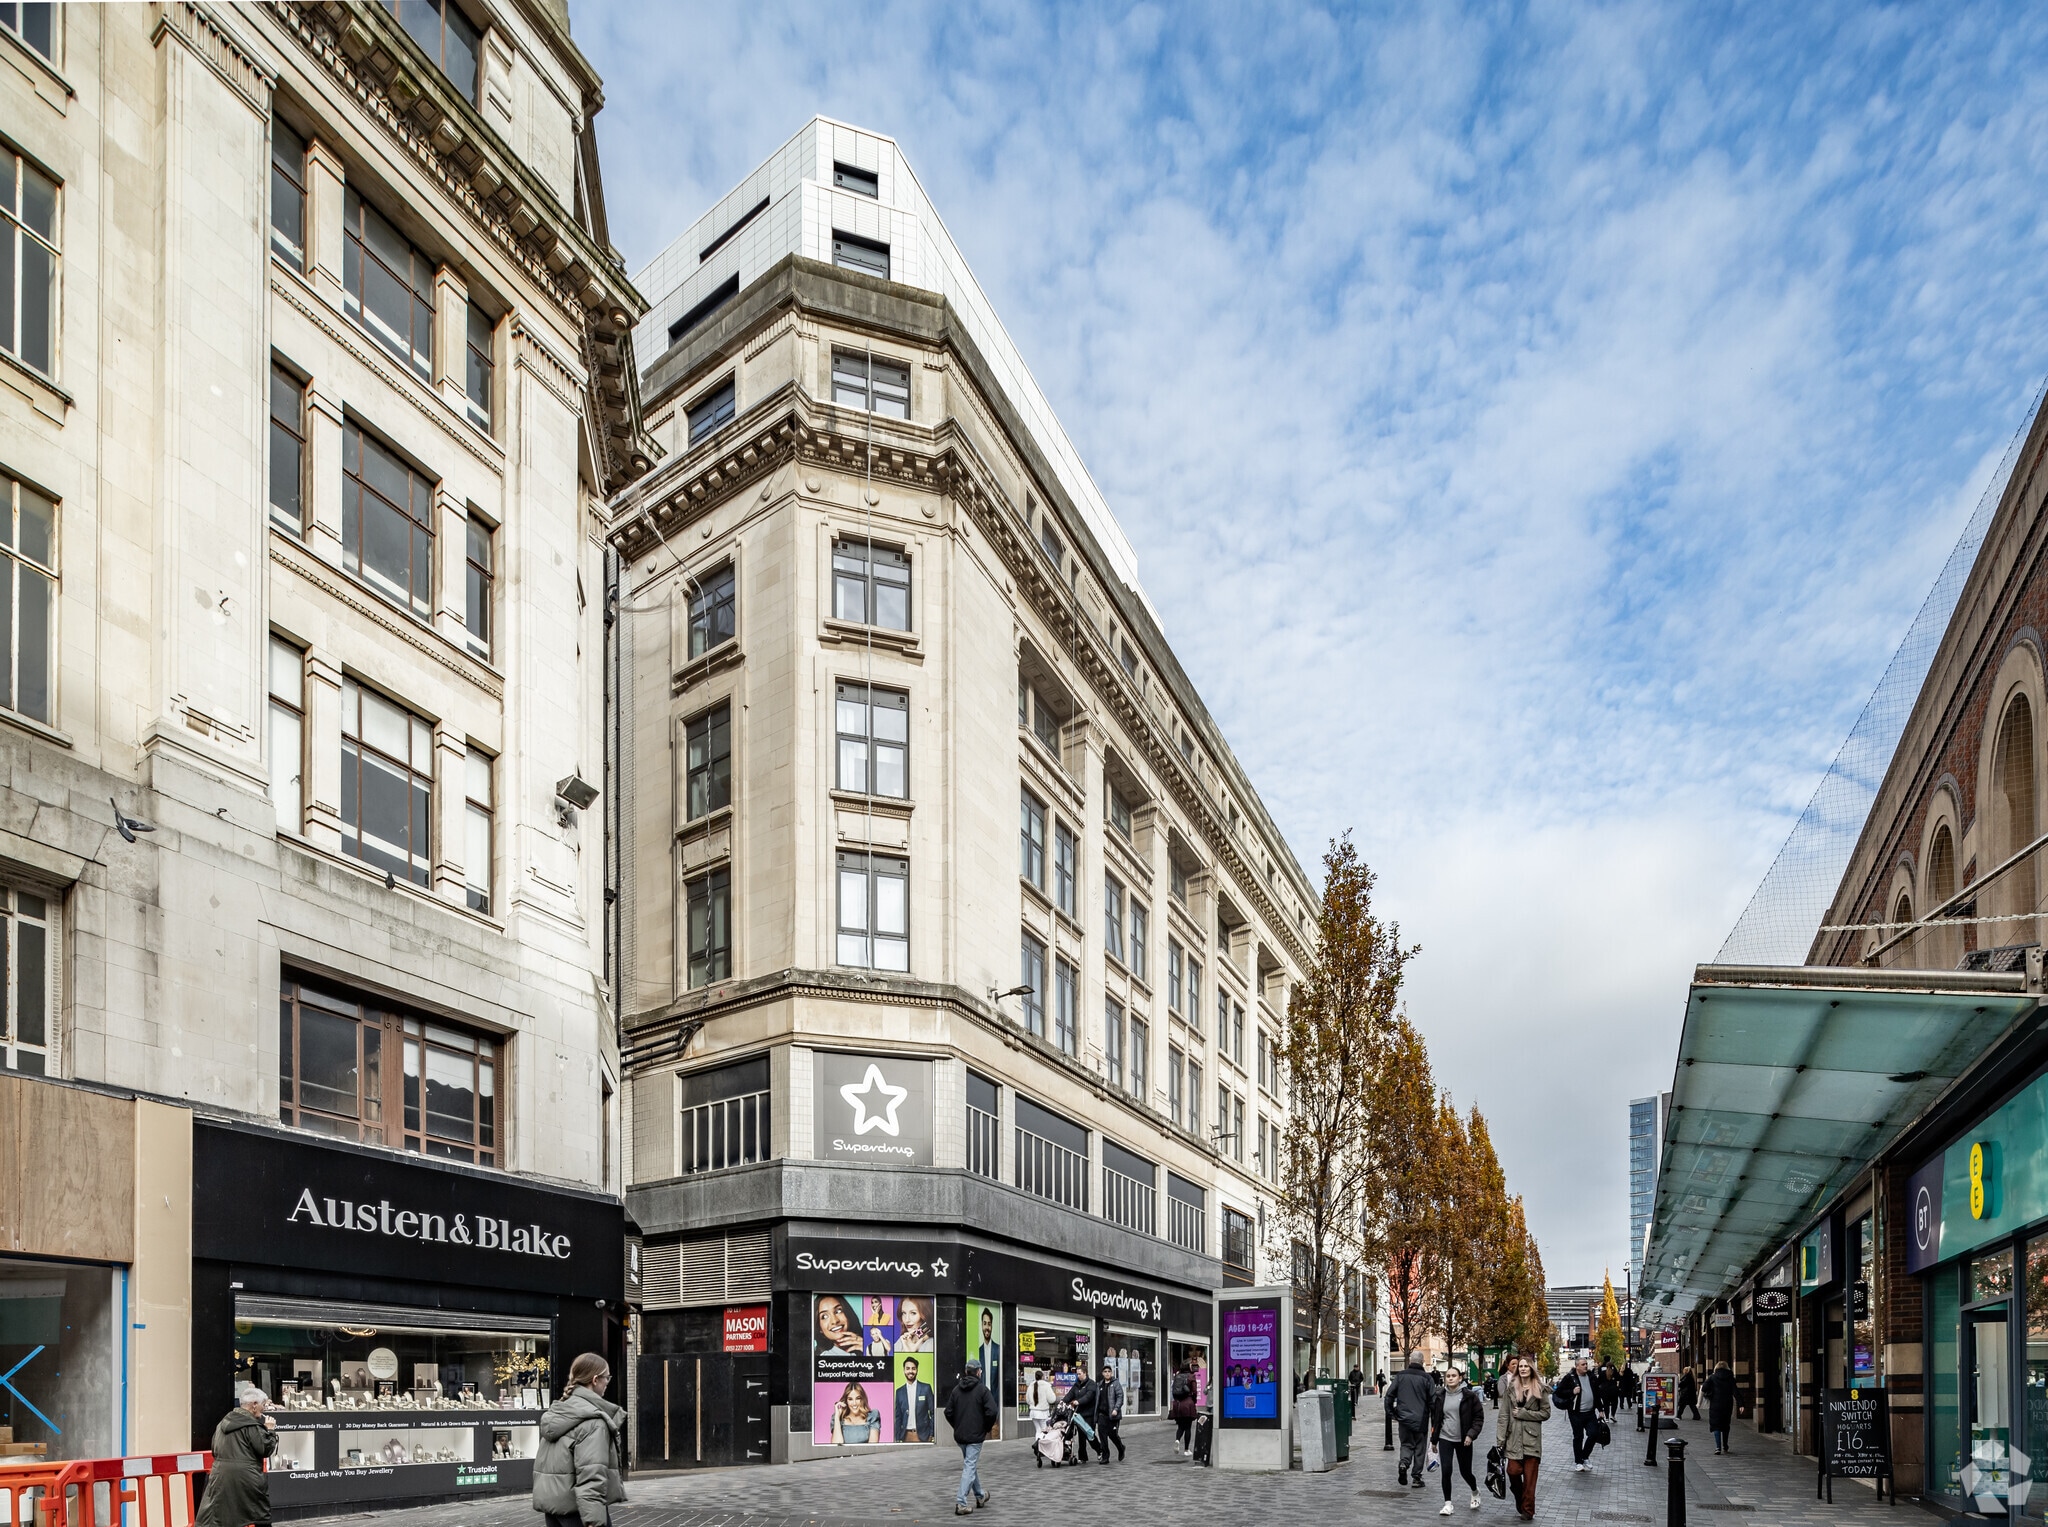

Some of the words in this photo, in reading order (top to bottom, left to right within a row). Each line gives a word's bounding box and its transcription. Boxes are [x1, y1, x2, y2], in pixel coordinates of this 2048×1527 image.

[833, 1139, 915, 1157] Superdrug
[1918, 1205, 1928, 1231] BT
[796, 1252, 924, 1278] Superdrug
[1071, 1277, 1149, 1320] Superdrug
[726, 1317, 765, 1332] MASON
[818, 1360, 874, 1370] Superdrug
[1829, 1400, 1877, 1411] NINTENDO
[1841, 1411, 1872, 1421] SWITCH
[1837, 1430, 1863, 1451] £16
[290, 1471, 318, 1479] Changing
[467, 1465, 498, 1474] Trustpilot
[1842, 1466, 1877, 1475] TODAY!
